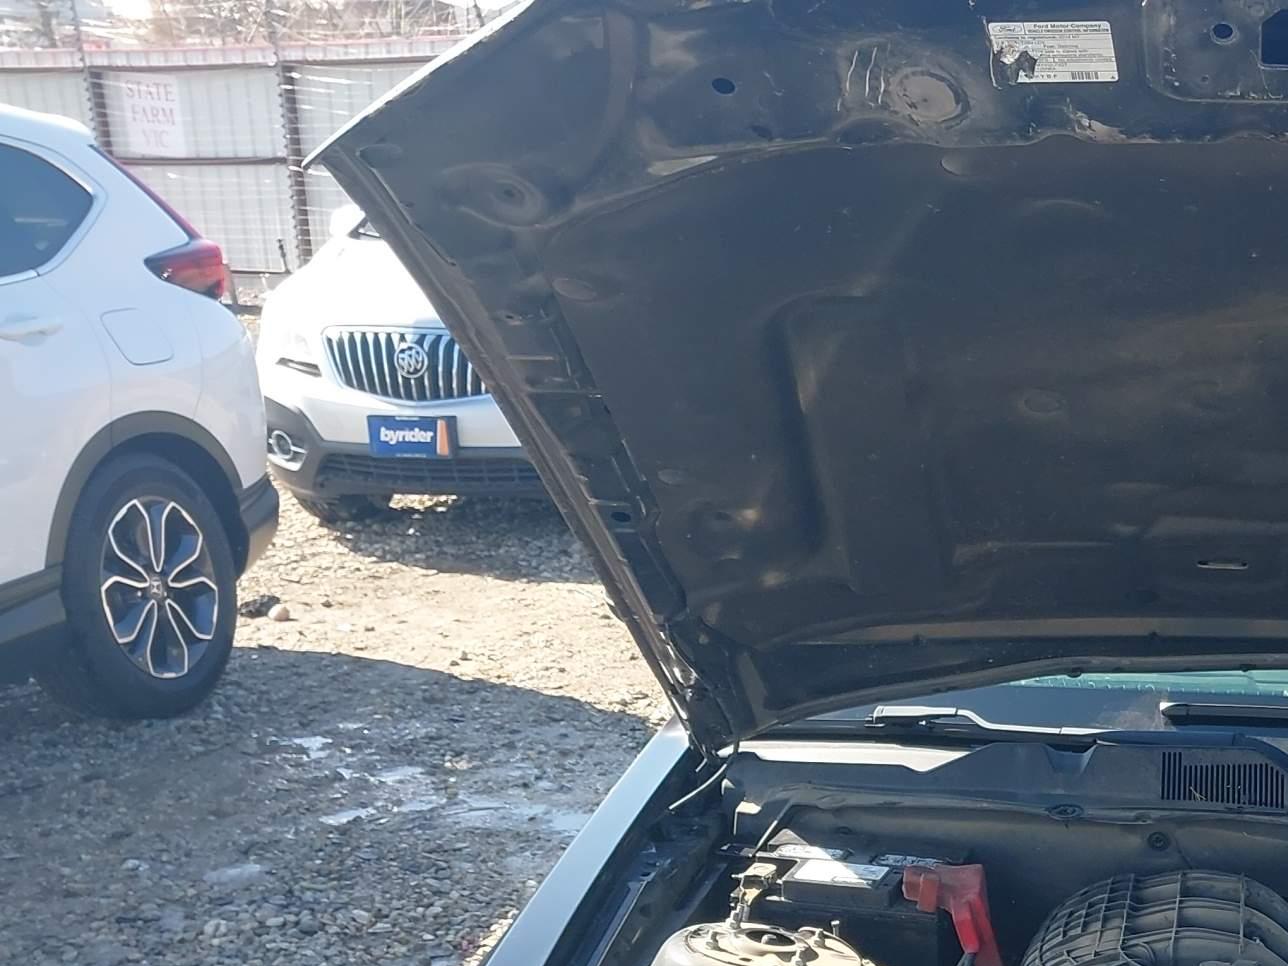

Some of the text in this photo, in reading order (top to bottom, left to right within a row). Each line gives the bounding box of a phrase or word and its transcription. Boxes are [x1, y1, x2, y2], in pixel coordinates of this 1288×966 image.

[125, 79, 176, 102] STATE
[131, 104, 176, 126] FARM
[379, 426, 434, 445] byrider
